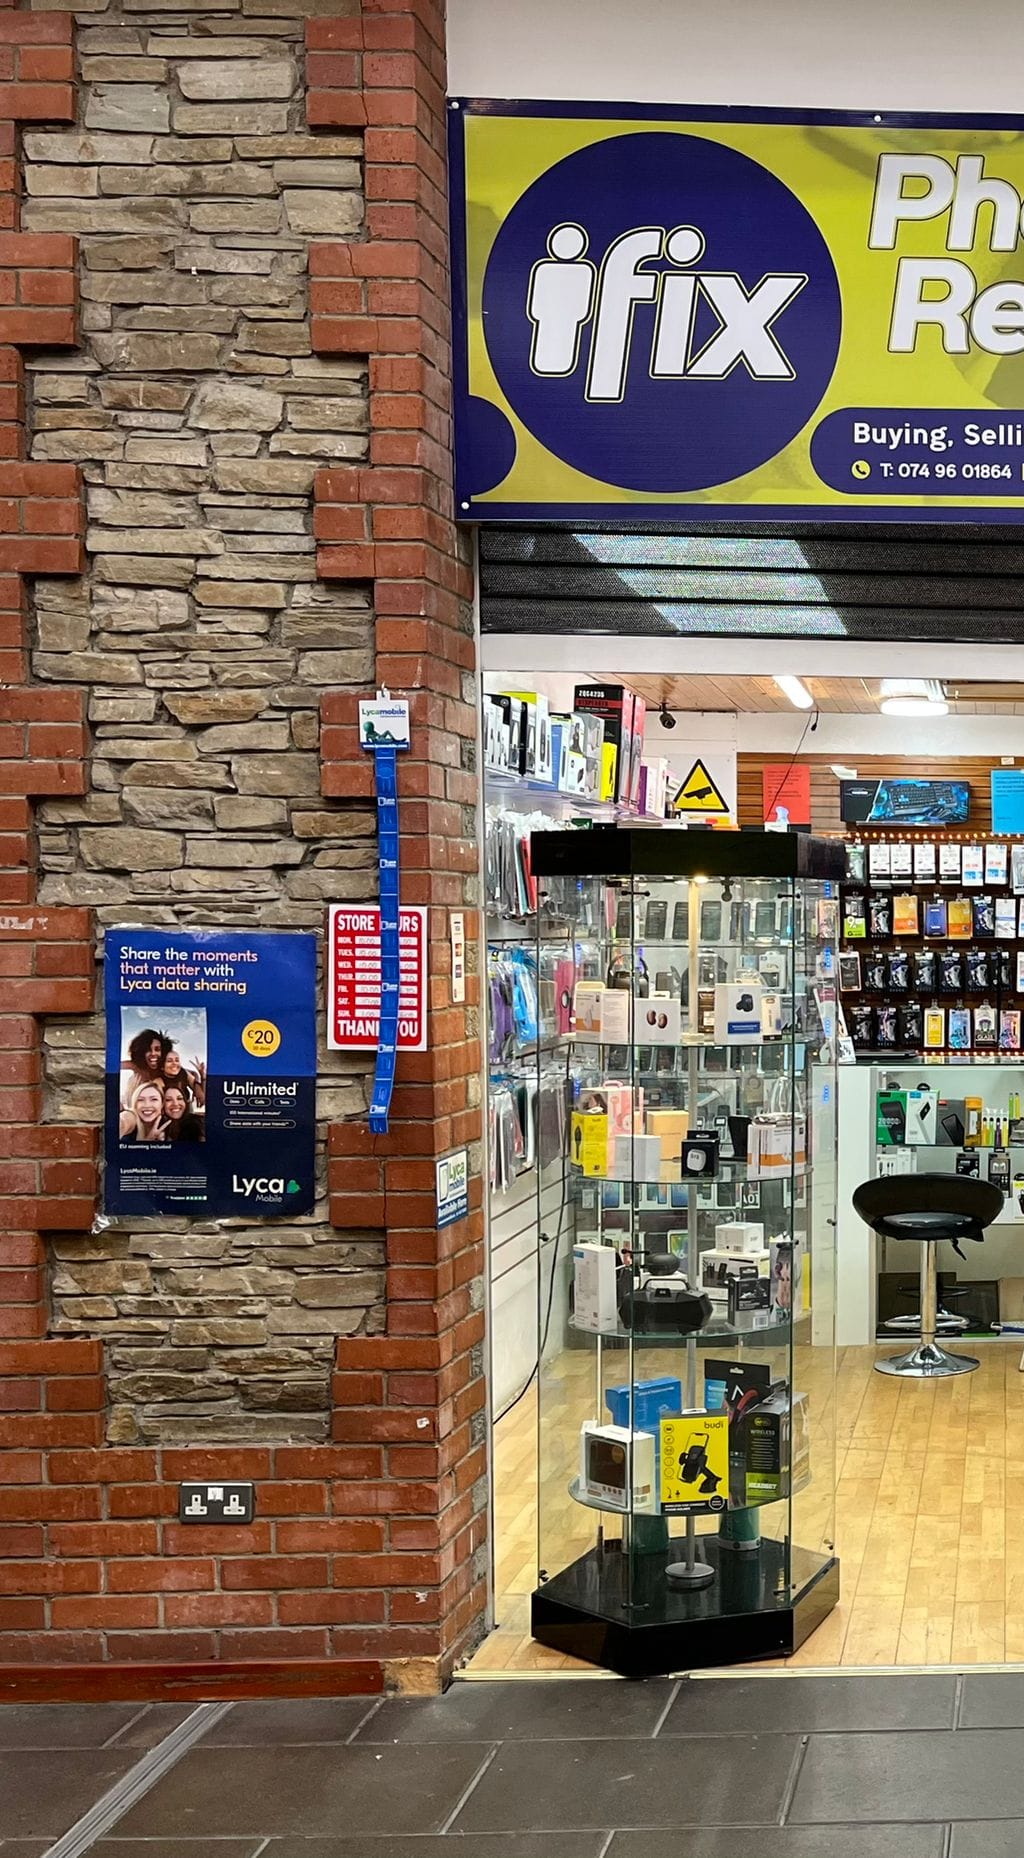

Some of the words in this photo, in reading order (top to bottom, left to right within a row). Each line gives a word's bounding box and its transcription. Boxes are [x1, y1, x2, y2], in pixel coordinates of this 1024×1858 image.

[528, 223, 808, 402] ifix
[853, 422, 954, 452] Buying,
[880, 463, 894, 478] T:
[898, 463, 930, 478] 074
[935, 464, 957, 479] 96
[962, 464, 1012, 479] 01864
[337, 914, 375, 931] STORE
[120, 946, 160, 960] Share
[165, 948, 188, 961] the
[192, 950, 258, 962] moments
[120, 963, 149, 975] that
[153, 964, 200, 976] matter
[204, 964, 234, 976] with
[120, 976, 152, 993] Lyca
[156, 977, 190, 991] data
[194, 979, 247, 994] sharing
[398, 1021, 418, 1037] OU
[232, 1175, 284, 1196] Lyca
[255, 1194, 283, 1203] Mobile
[704, 1420, 724, 1429] budi
